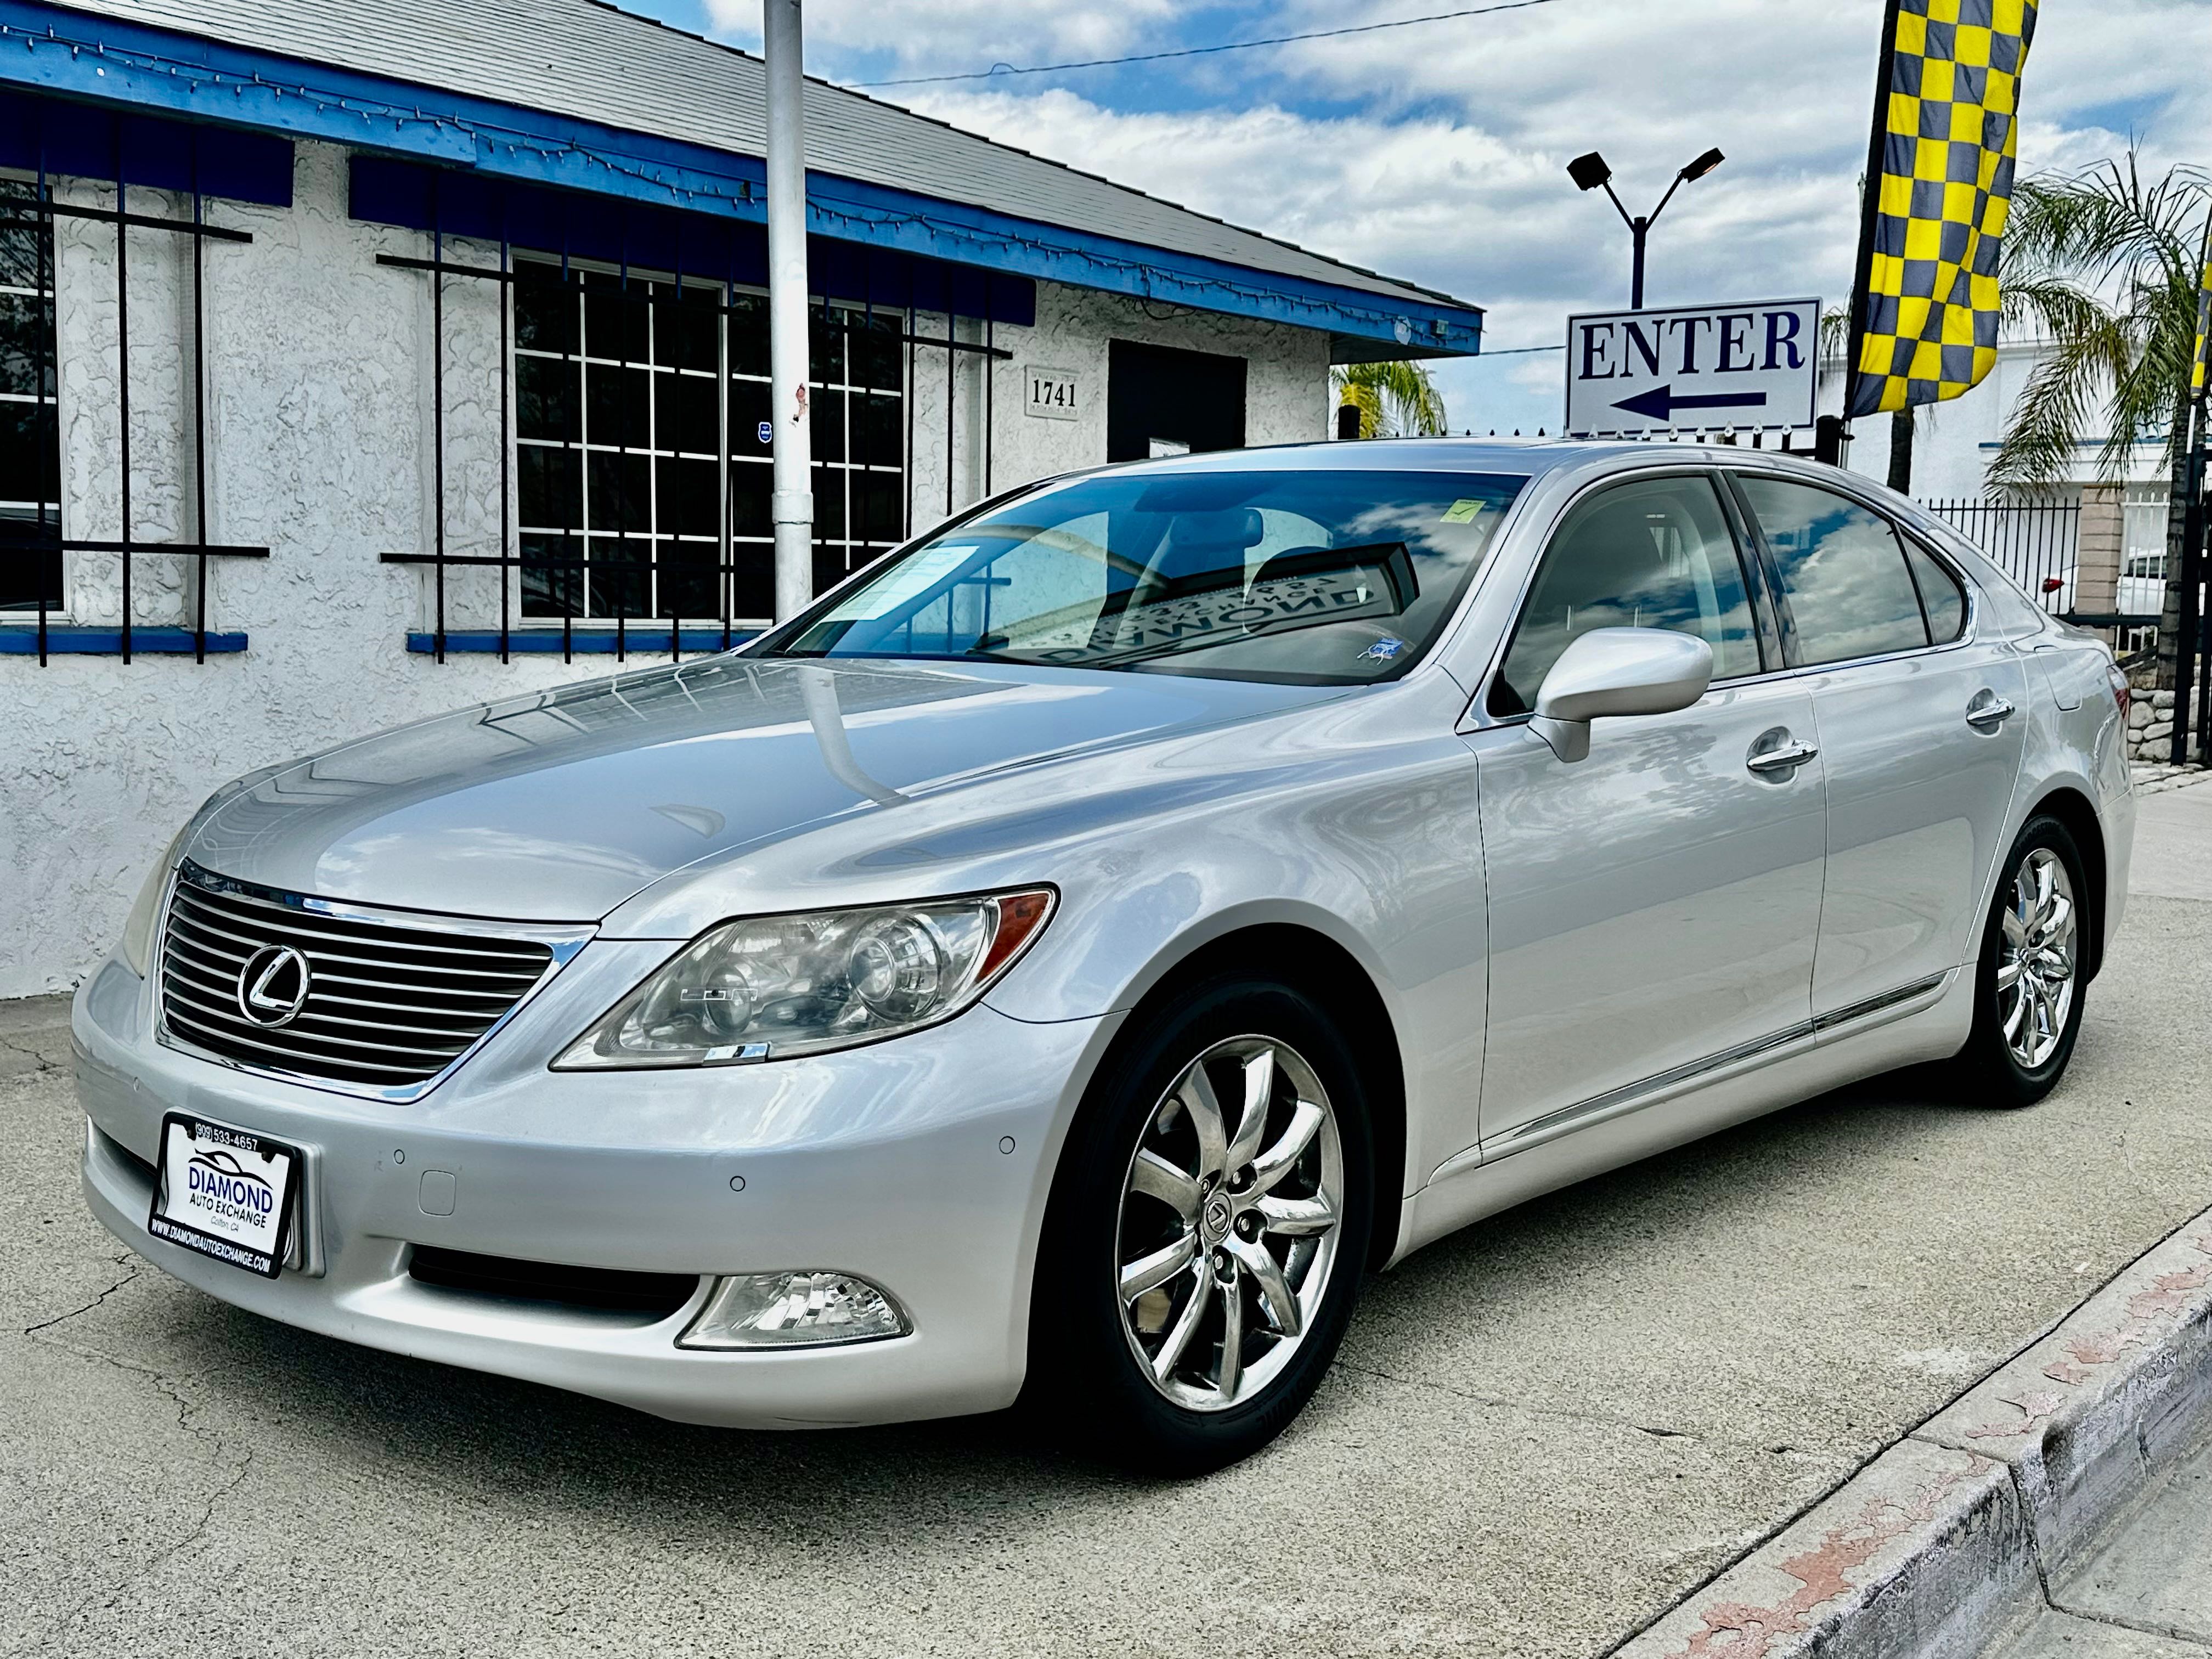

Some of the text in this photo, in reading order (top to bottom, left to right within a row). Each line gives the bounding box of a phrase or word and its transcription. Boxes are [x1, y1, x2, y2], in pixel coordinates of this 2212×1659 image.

[1578, 311, 1805, 380] ENTER
[1033, 379, 1075, 408] 1741
[213, 1128, 258, 1151] 533-4657
[189, 1166, 273, 1213] DIAMOND
[189, 1193, 267, 1228] AUTO EXCHANGE
[151, 1218, 270, 1273] WWW.DIAMONDAUTOEXCHANGE.COM
